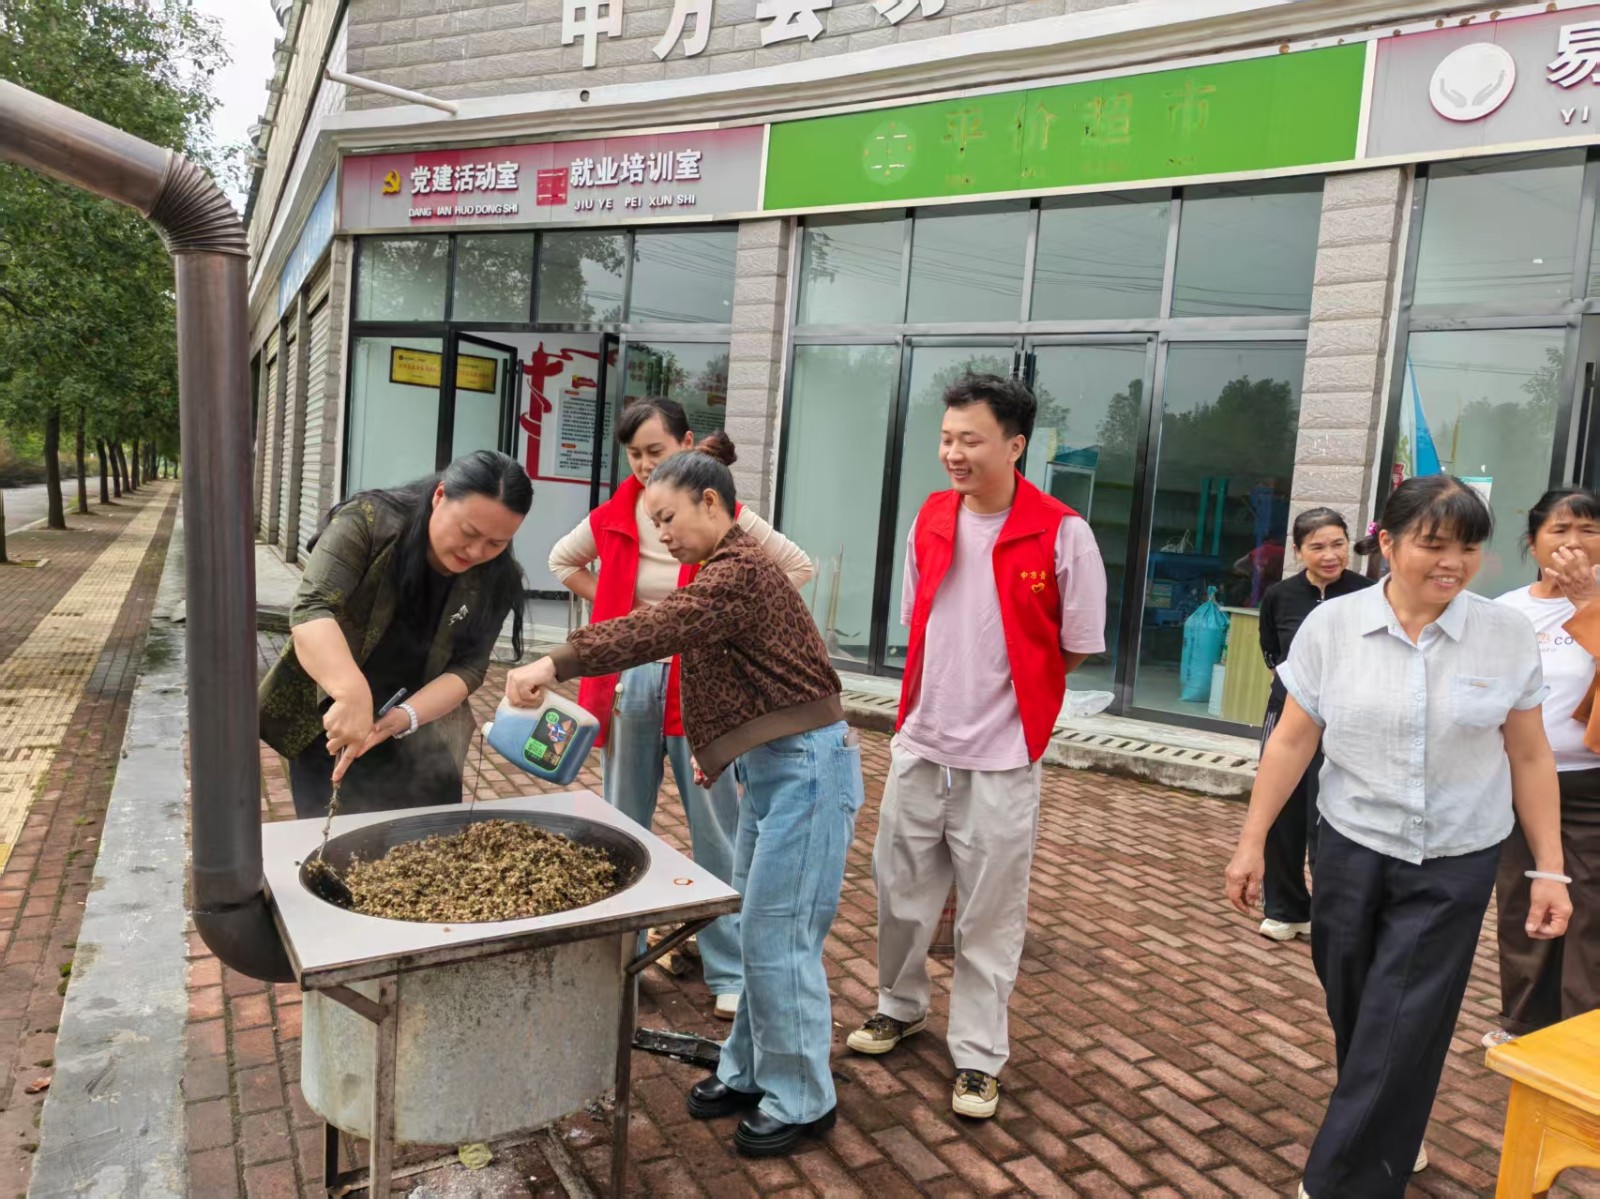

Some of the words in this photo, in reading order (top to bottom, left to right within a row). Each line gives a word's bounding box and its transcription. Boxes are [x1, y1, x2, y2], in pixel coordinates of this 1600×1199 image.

[410, 160, 519, 195] 党建活动室
[569, 148, 702, 188] 就业培训室
[408, 207, 432, 218] DANG
[454, 204, 474, 215] HUO
[475, 203, 503, 215] DONG
[503, 202, 519, 214] SHI
[574, 198, 594, 211] JIU
[598, 197, 613, 210] YE
[624, 195, 643, 208] PEI
[649, 194, 673, 207] XUN
[676, 193, 696, 206] SHI
